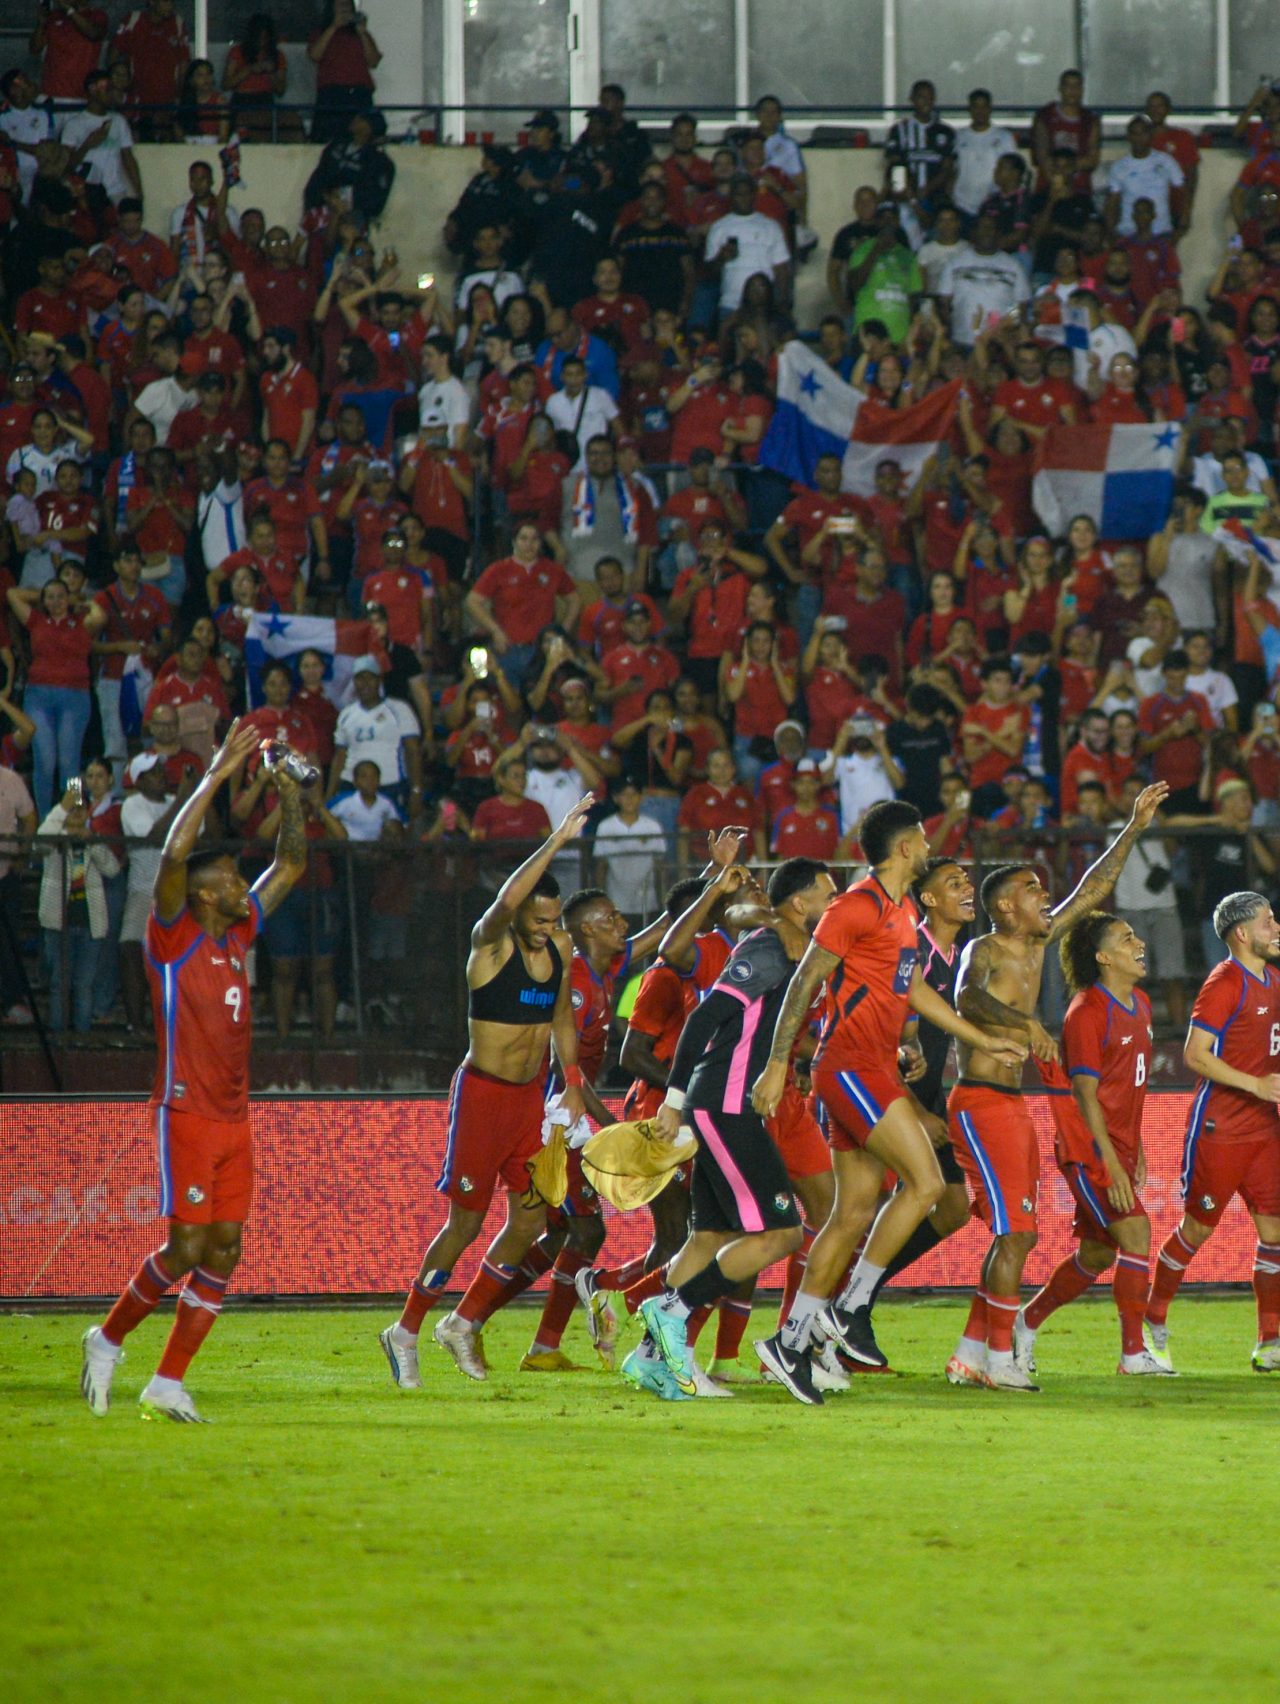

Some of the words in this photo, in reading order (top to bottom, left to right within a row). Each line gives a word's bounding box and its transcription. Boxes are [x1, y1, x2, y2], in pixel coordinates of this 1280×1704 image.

[47, 511, 64, 530] 16
[225, 986, 240, 1024] 9
[1269, 1023, 1280, 1056] 6
[1135, 1053, 1146, 1087] 8
